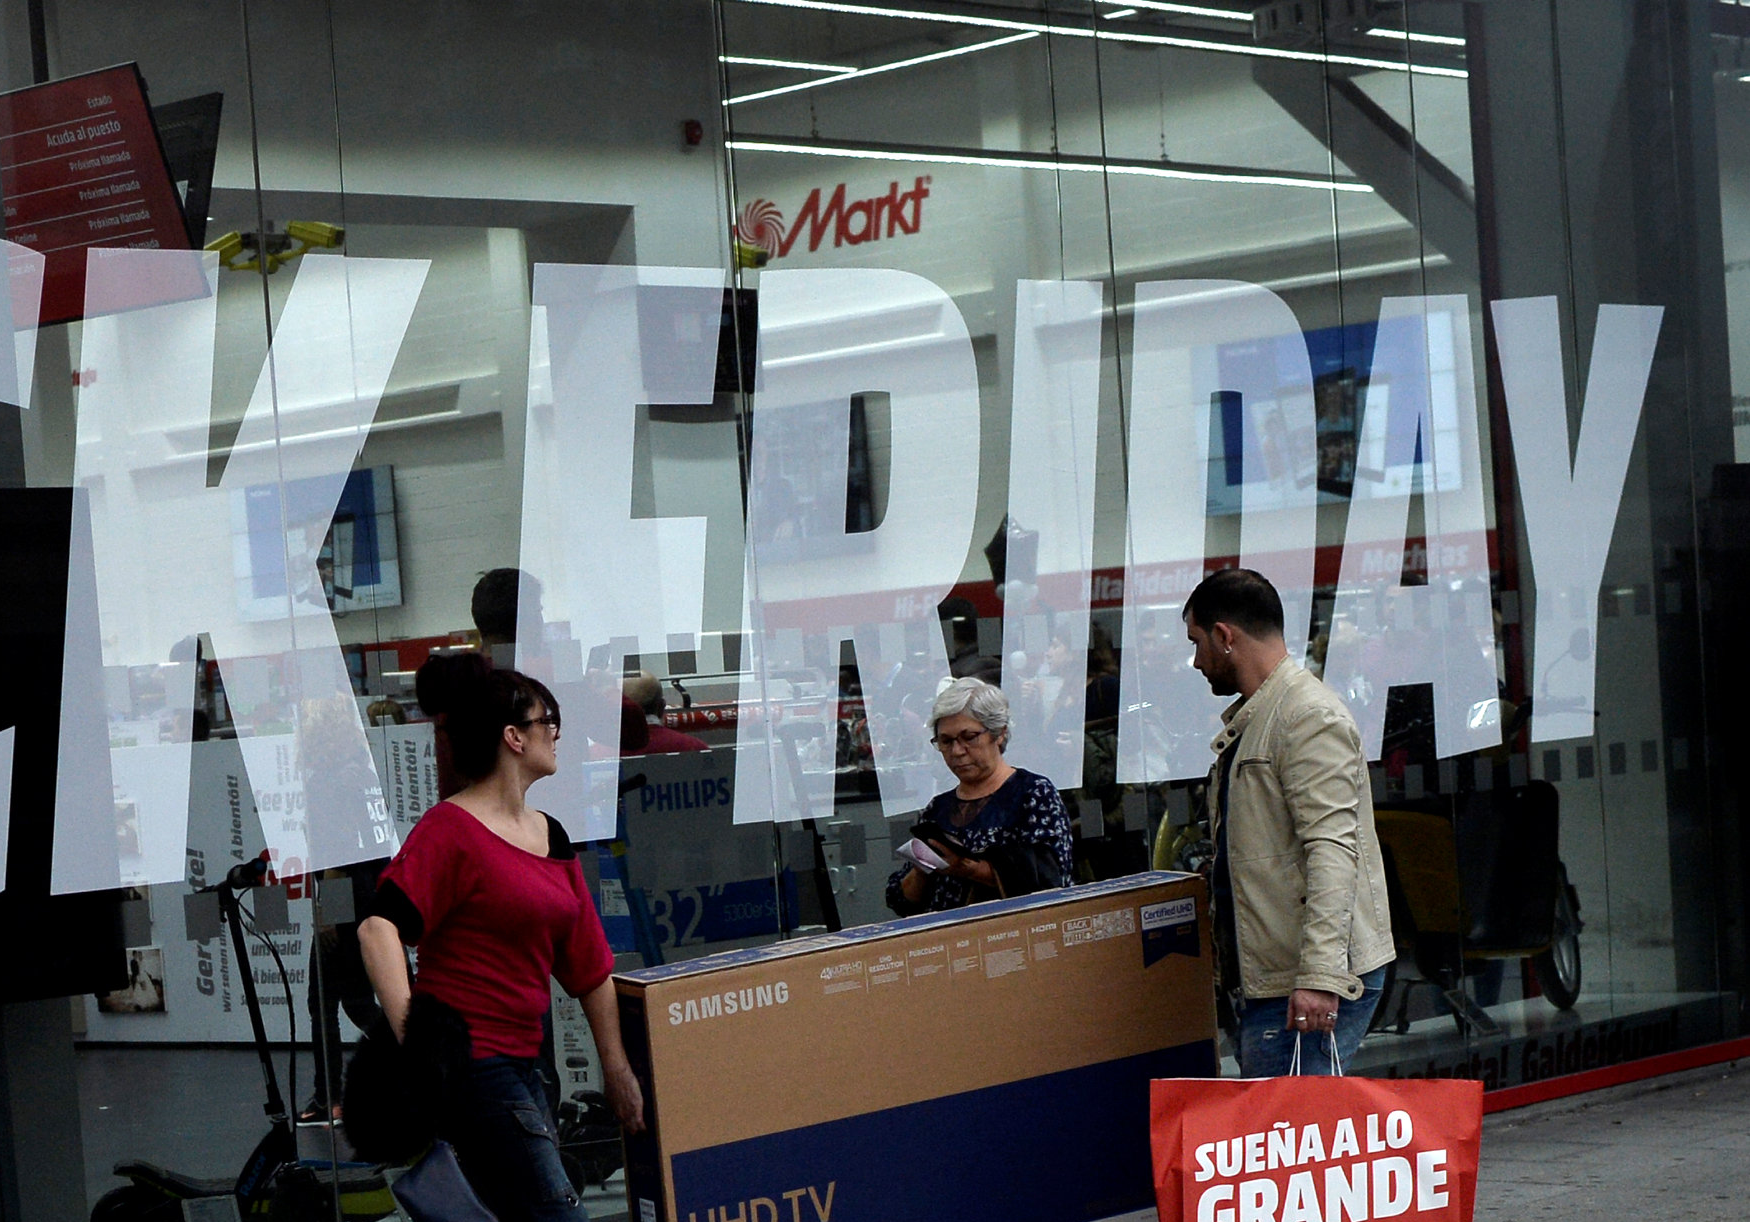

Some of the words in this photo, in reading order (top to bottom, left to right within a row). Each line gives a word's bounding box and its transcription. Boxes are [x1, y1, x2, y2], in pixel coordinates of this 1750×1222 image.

[46, 130, 75, 148] Acuda
[77, 126, 87, 140] al
[88, 119, 121, 138] puesto
[69, 157, 100, 172] Próxima
[101, 150, 132, 166] llamada
[79, 186, 110, 201] Próxima
[110, 180, 140, 195] llamada
[88, 215, 120, 230] Próxima
[120, 209, 151, 224] llamada
[778, 176, 930, 258] Markt
[506, 263, 1666, 842] FRIDAY
[640, 777, 731, 814] PHILIPS
[1142, 905, 1176, 920] Certified
[1176, 902, 1194, 914] UHD
[1066, 920, 1088, 931] BACK
[868, 960, 904, 973] RESOLUTION
[878, 954, 893, 964] UHD
[668, 981, 790, 1026] SAMSUNG
[1194, 1120, 1325, 1183] SUEÑA
[1330, 1118, 1360, 1162] A
[1367, 1110, 1414, 1154] LO
